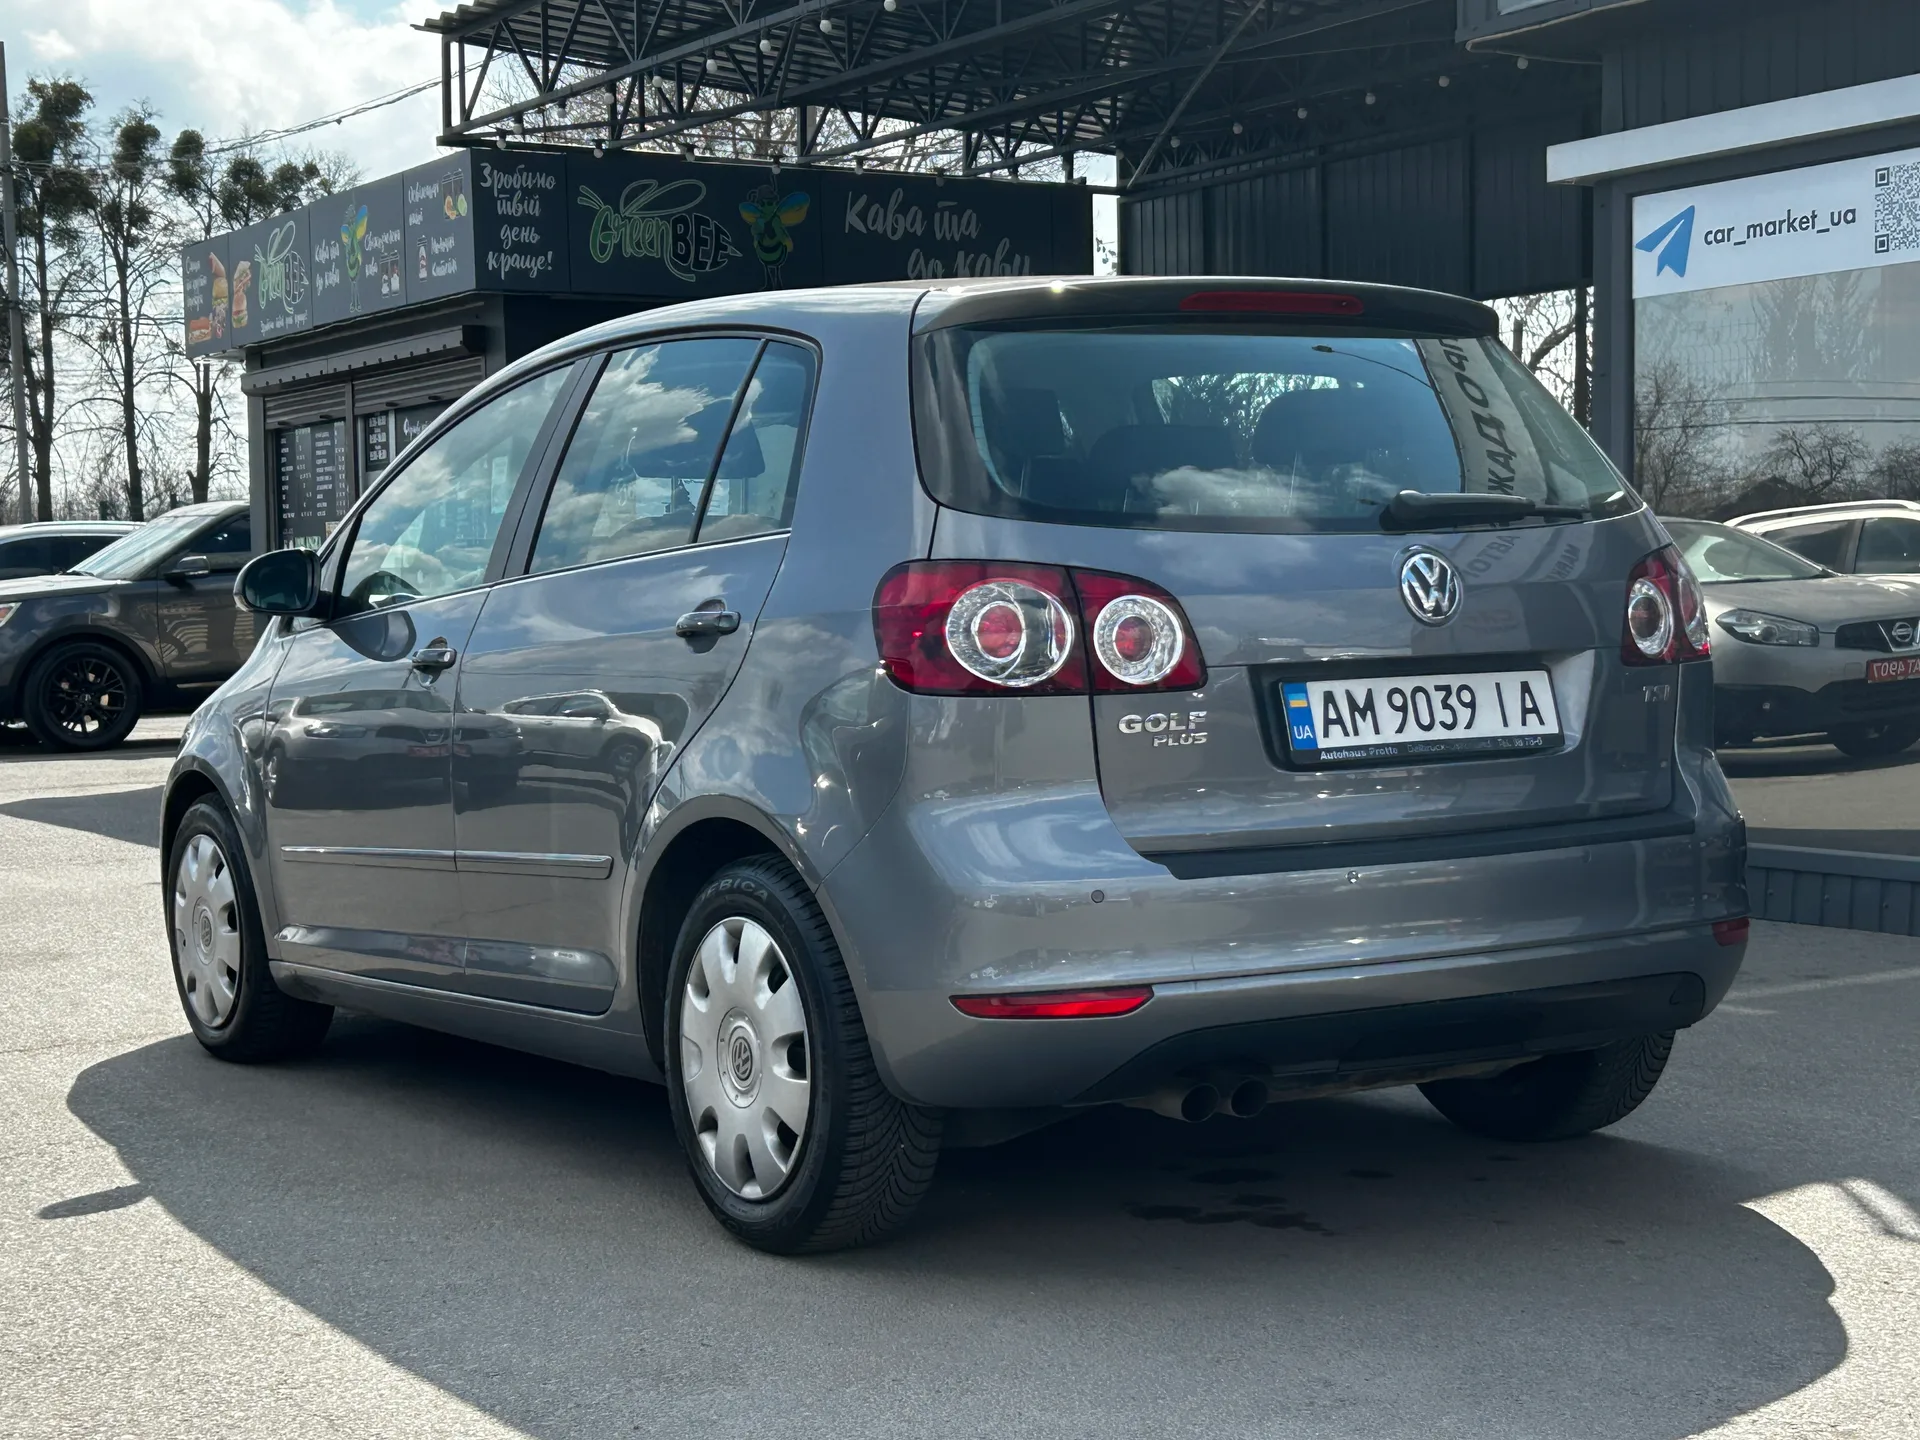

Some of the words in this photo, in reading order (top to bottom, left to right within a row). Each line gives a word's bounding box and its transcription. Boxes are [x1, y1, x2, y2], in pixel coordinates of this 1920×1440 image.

[480, 162, 556, 197] Зробимо
[496, 191, 542, 217] твій
[845, 187, 927, 241] Кава
[933, 200, 982, 242] та
[500, 223, 541, 244] день
[1703, 208, 1857, 246] car_market_ua
[486, 251, 553, 280] краще!
[1118, 710, 1208, 734] GOLF
[1323, 687, 1381, 739] AM
[1386, 683, 1477, 735] 9039
[1153, 732, 1208, 747] PLUS
[1293, 725, 1315, 741] UA
[1320, 749, 1367, 761] Autohaus
